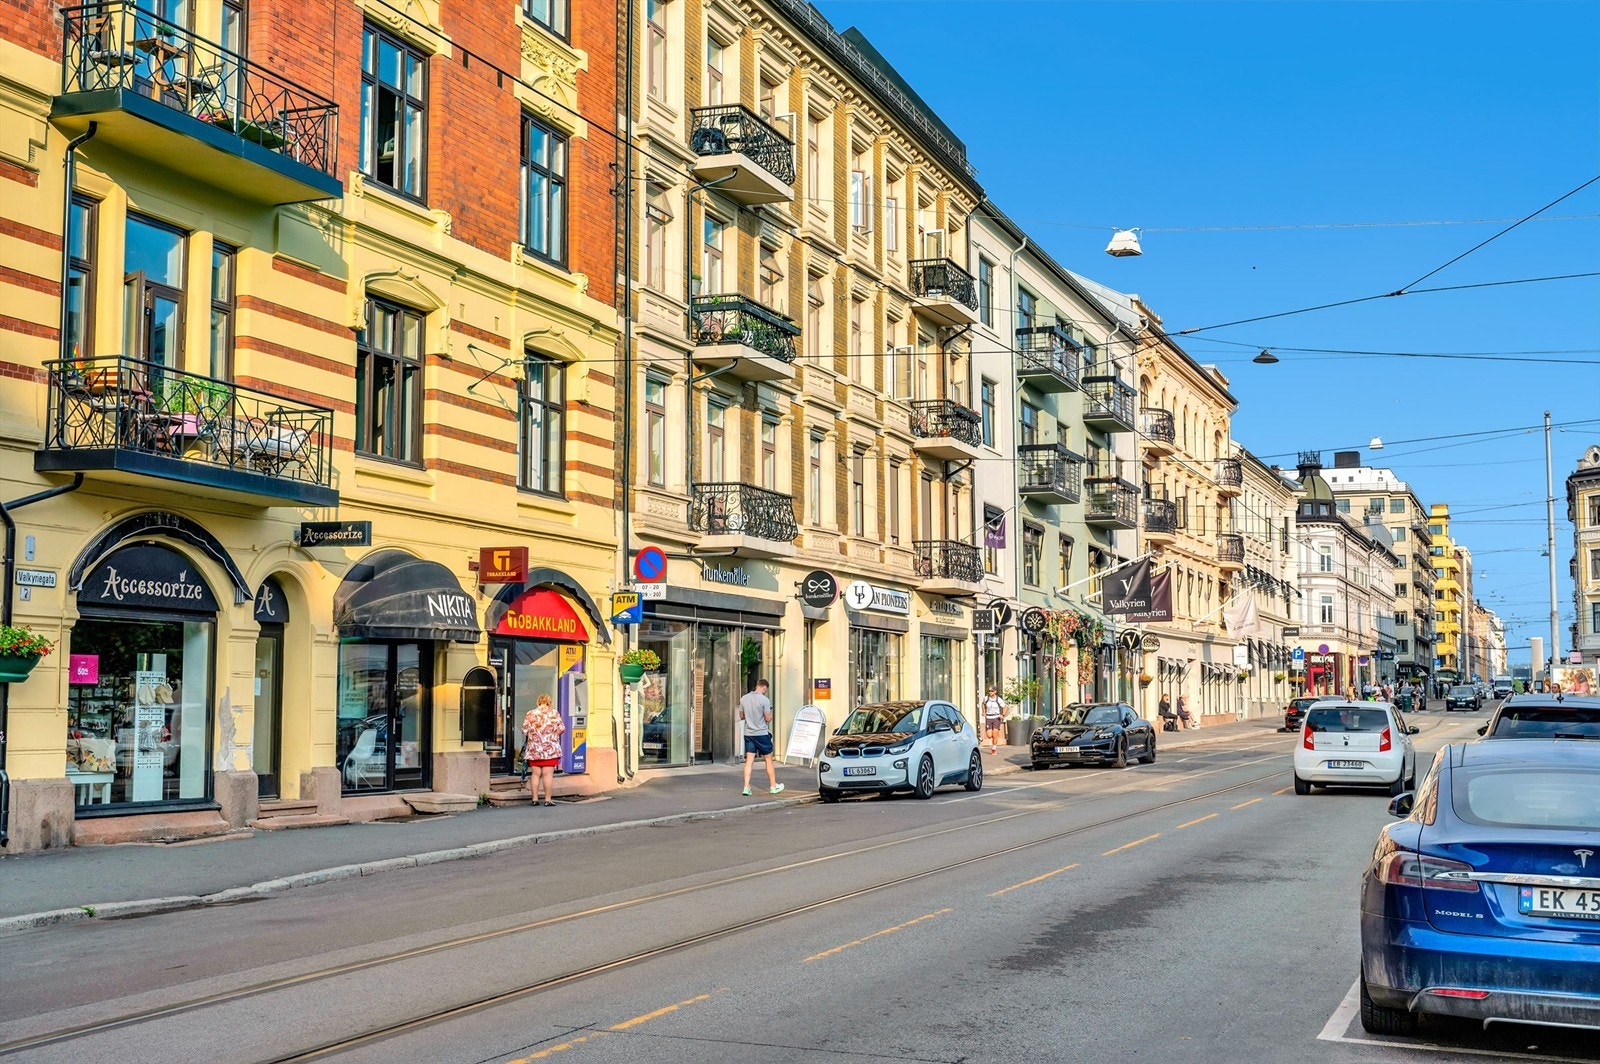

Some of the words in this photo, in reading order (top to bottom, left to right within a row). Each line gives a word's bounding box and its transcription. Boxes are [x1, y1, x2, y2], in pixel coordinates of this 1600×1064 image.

[303, 525, 363, 543] Accessorize
[18, 571, 55, 586] Valkyriegata
[703, 560, 750, 586] hunkemöller
[101, 566, 203, 601] Accessorize
[23, 588, 29, 599] 7
[256, 583, 276, 616] A
[616, 595, 636, 604] ATM
[881, 593, 908, 610] PIONEERS
[427, 594, 473, 620] NIKITA
[1110, 599, 1146, 610] Valkyrien
[507, 610, 577, 633] TOBAKKLAND
[1295, 650, 1302, 659] P
[1540, 890, 1565, 910] EK
[1575, 892, 1600, 912] 45
[1435, 910, 1473, 918] MODEL
